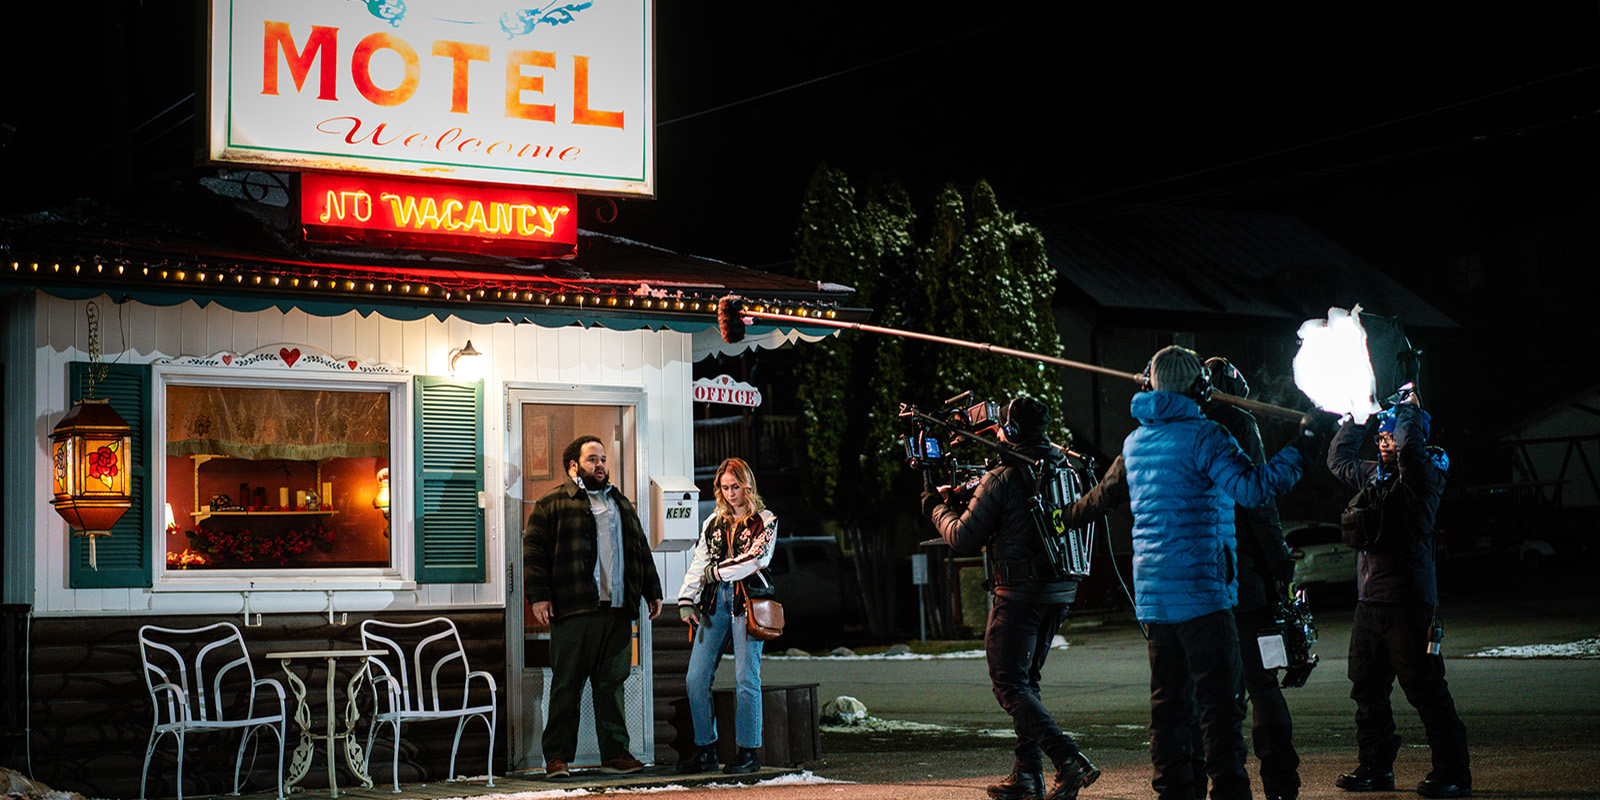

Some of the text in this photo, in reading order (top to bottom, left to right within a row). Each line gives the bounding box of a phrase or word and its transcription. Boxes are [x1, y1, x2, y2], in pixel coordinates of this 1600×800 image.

[260, 20, 625, 131] MOTEL
[316, 116, 582, 163] Welcome
[320, 190, 569, 237] NO VACANCY
[694, 385, 756, 405] OFFICE
[666, 507, 692, 519] KEYS
